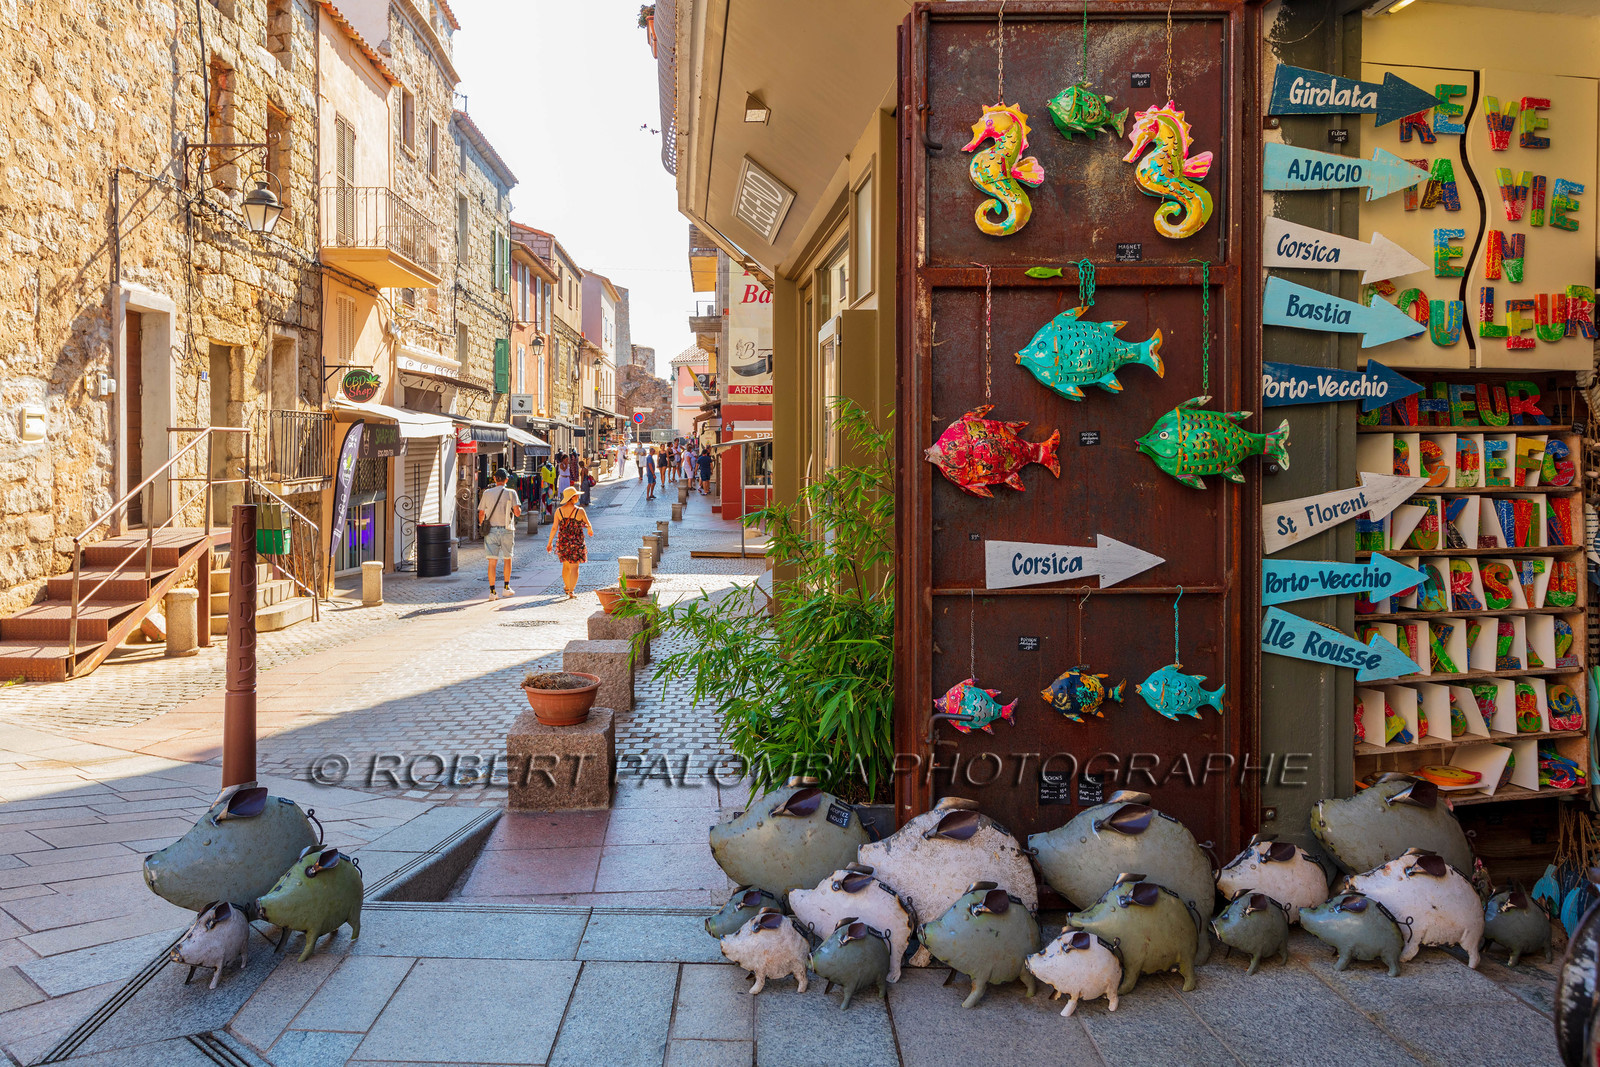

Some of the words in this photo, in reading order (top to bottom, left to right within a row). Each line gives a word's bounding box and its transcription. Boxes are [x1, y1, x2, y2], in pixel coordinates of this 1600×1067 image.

[1289, 77, 1377, 109] Girolata
[1287, 159, 1362, 183] AJACCIO
[738, 170, 783, 237] LEGEND
[1495, 167, 1585, 231] VIE
[1276, 233, 1340, 264] Corsica
[740, 284, 774, 304] Ba
[1285, 294, 1352, 325] Bastia
[345, 375, 367, 388] CBD
[348, 385, 373, 398] Shop
[734, 385, 772, 394] ARTISAN
[1263, 373, 1388, 399] Porto-Vecchio
[1456, 438, 1480, 487] D
[1484, 440, 1510, 487] E
[1515, 437, 1545, 487] F
[1540, 439, 1575, 487] G
[1277, 514, 1298, 537] St
[1304, 492, 1369, 527] Florent
[1012, 552, 1083, 576] Corsica
[1264, 559, 1392, 594] Porto-Vecchio
[1450, 559, 1483, 611] R
[1479, 562, 1513, 610] S
[1514, 560, 1546, 609] T
[1546, 561, 1577, 607] U
[1262, 617, 1294, 649] Ile
[1303, 631, 1382, 670] Rousse
[1515, 683, 1542, 733] 8
